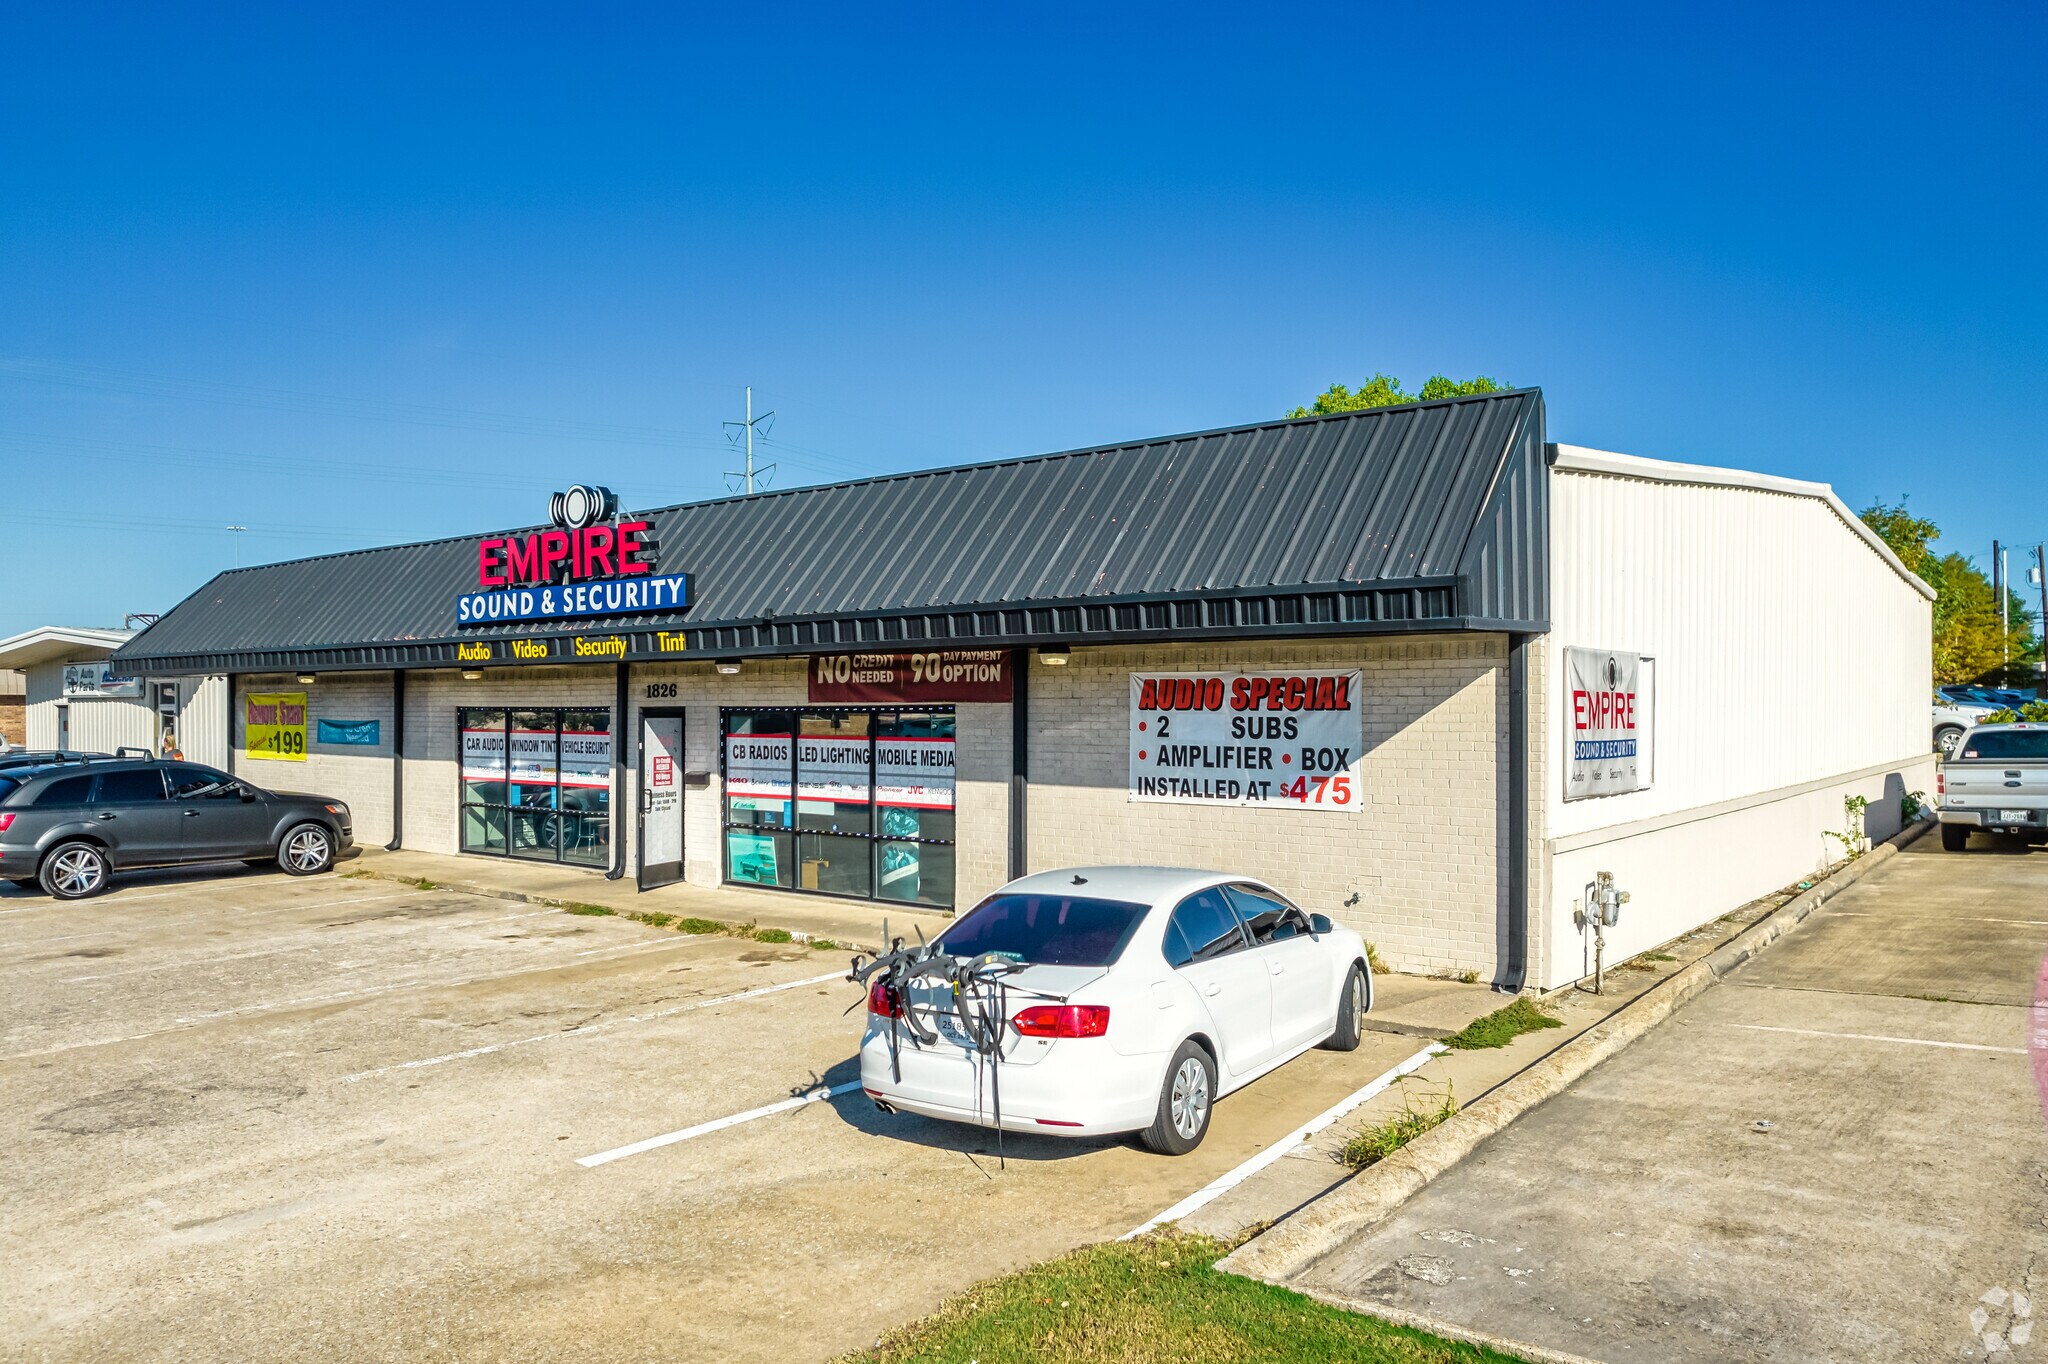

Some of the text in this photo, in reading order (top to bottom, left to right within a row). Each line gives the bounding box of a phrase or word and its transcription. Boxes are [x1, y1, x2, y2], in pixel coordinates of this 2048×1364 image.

[480, 521, 651, 586] EMPIRE
[460, 577, 685, 621] SOUND & SECURITY
[458, 631, 685, 660] Audio Video Security Tint
[81, 668, 94, 679] Auto
[817, 654, 894, 684] NO CREDIT
[911, 651, 1002, 683] 90 DAY PAYMENT
[943, 664, 1001, 682] OPTION
[80, 681, 95, 691] Parts
[852, 671, 894, 683] NEEDED
[646, 683, 678, 699] 1826
[1138, 677, 1352, 711] AUDIO SPECIAL
[280, 701, 305, 725] START
[1573, 690, 1636, 730] EMPIRE
[1157, 716, 1298, 740] 2 SUBS
[268, 731, 303, 754] $199
[467, 738, 504, 751] CAR AUDIO
[511, 740, 557, 753] WINDOW TINT
[561, 740, 584, 754] VEHICLE
[1575, 742, 1600, 759] SOUND
[1606, 741, 1636, 757] SECURITY
[733, 744, 788, 760] CB RADIOS
[800, 747, 870, 765] LED LIGHTING
[878, 749, 956, 767] MOBILE MEDIA
[1157, 745, 1350, 772] AMPLIFIER BOX
[908, 786, 924, 794] JVC
[1138, 775, 1352, 805] INSTALLED AT $475
